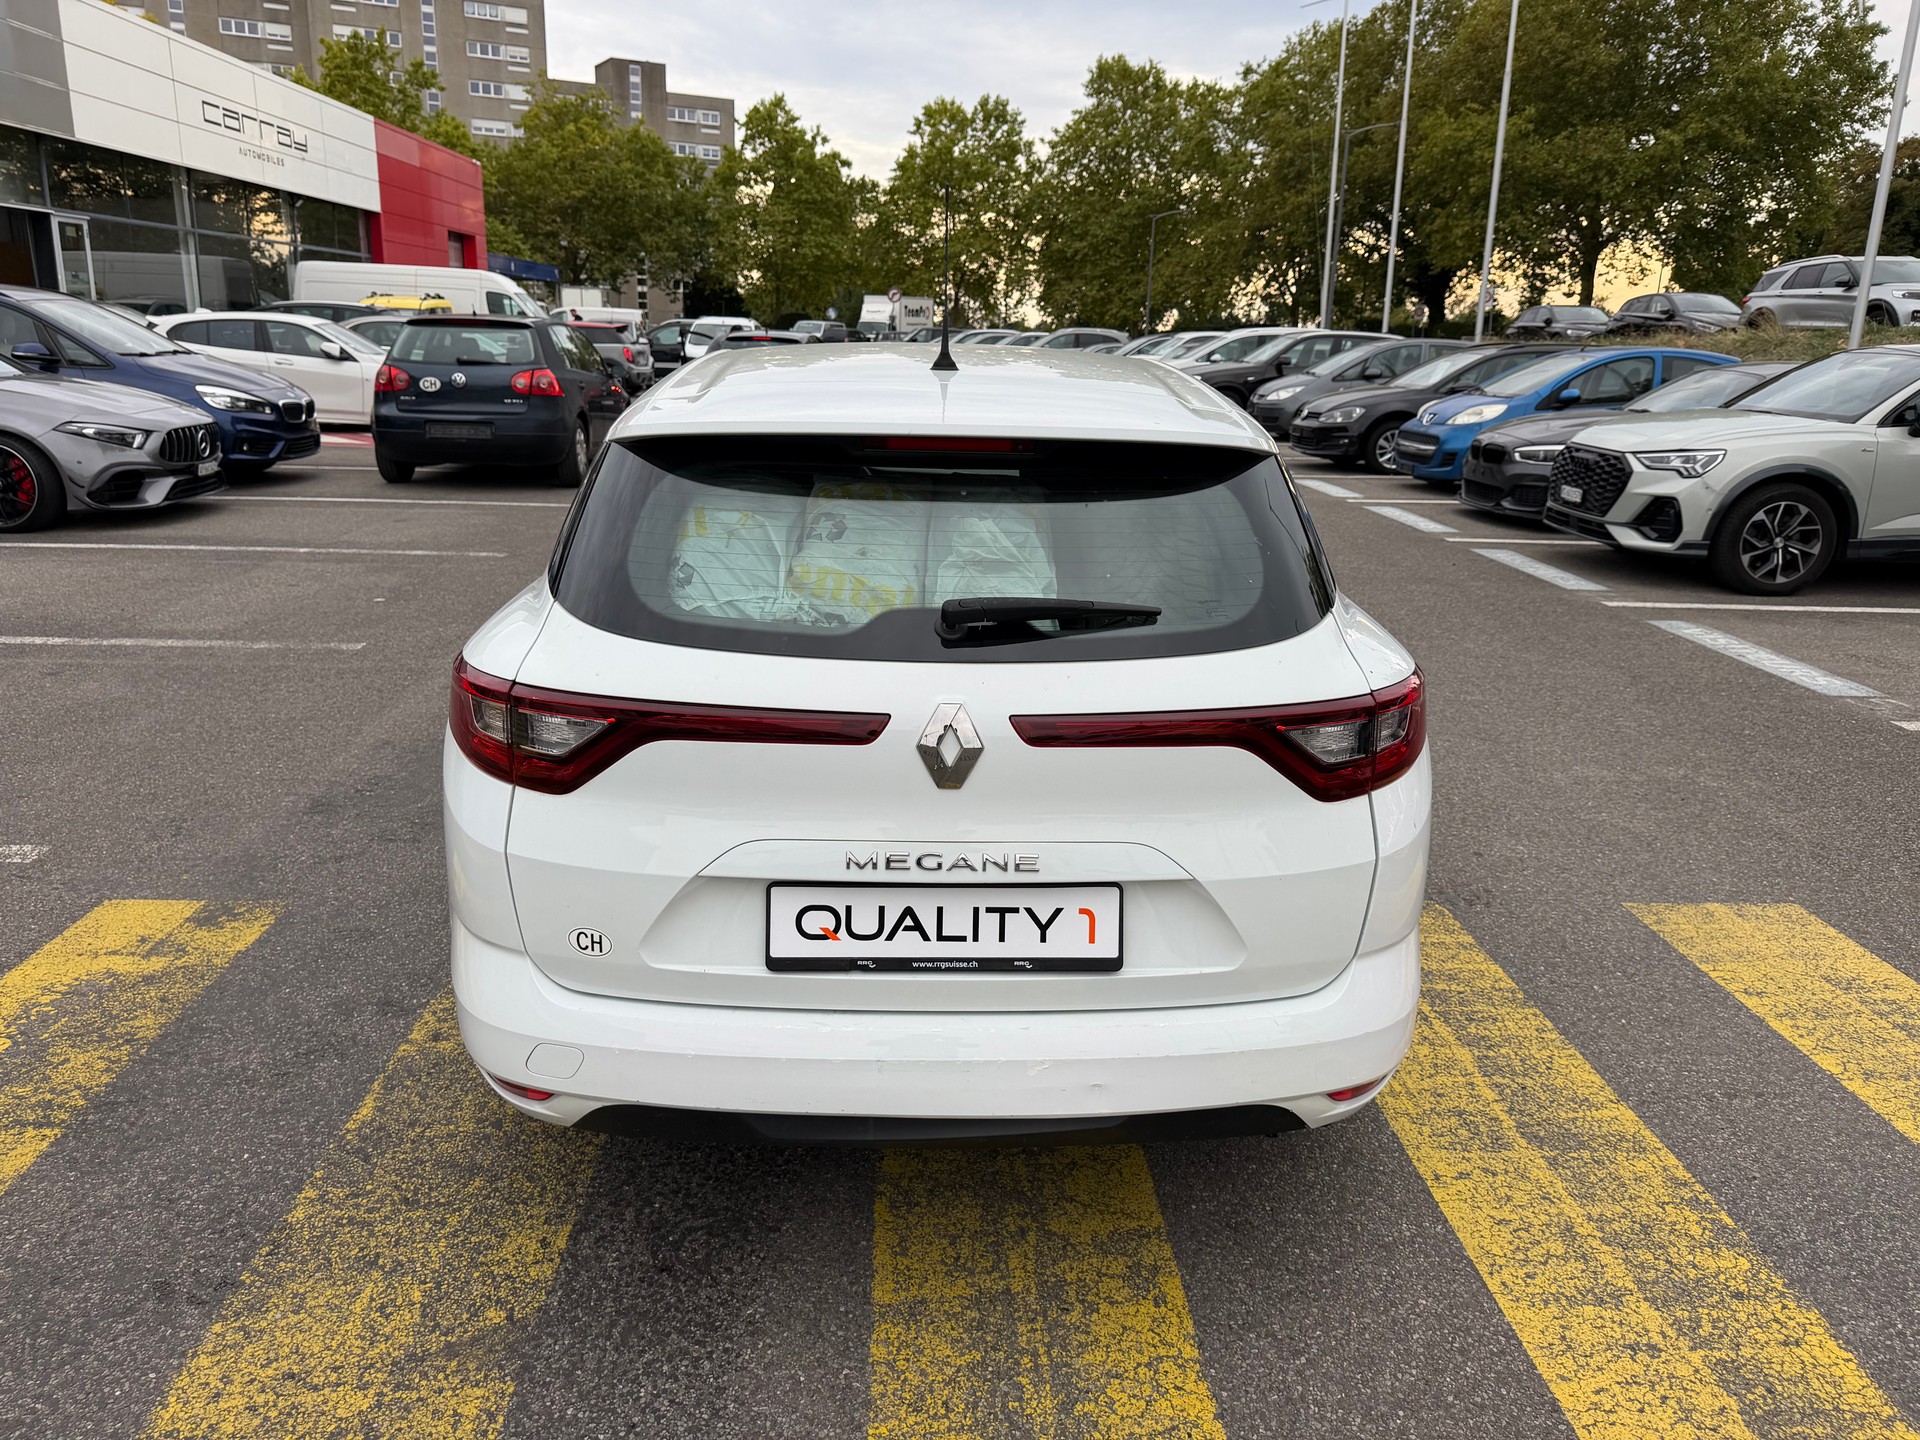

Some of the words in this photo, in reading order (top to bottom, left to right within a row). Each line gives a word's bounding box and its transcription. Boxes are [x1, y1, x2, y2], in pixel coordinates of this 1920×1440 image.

[201, 100, 308, 153] carray
[239, 146, 285, 167] AUTOMOBILES
[422, 379, 438, 390] CH
[845, 850, 1040, 873] MEGANE
[795, 904, 1065, 944] QUALITY
[1078, 907, 1097, 945] 1
[576, 931, 603, 953] CH
[911, 960, 979, 970] www.rrgsuisse.ch
